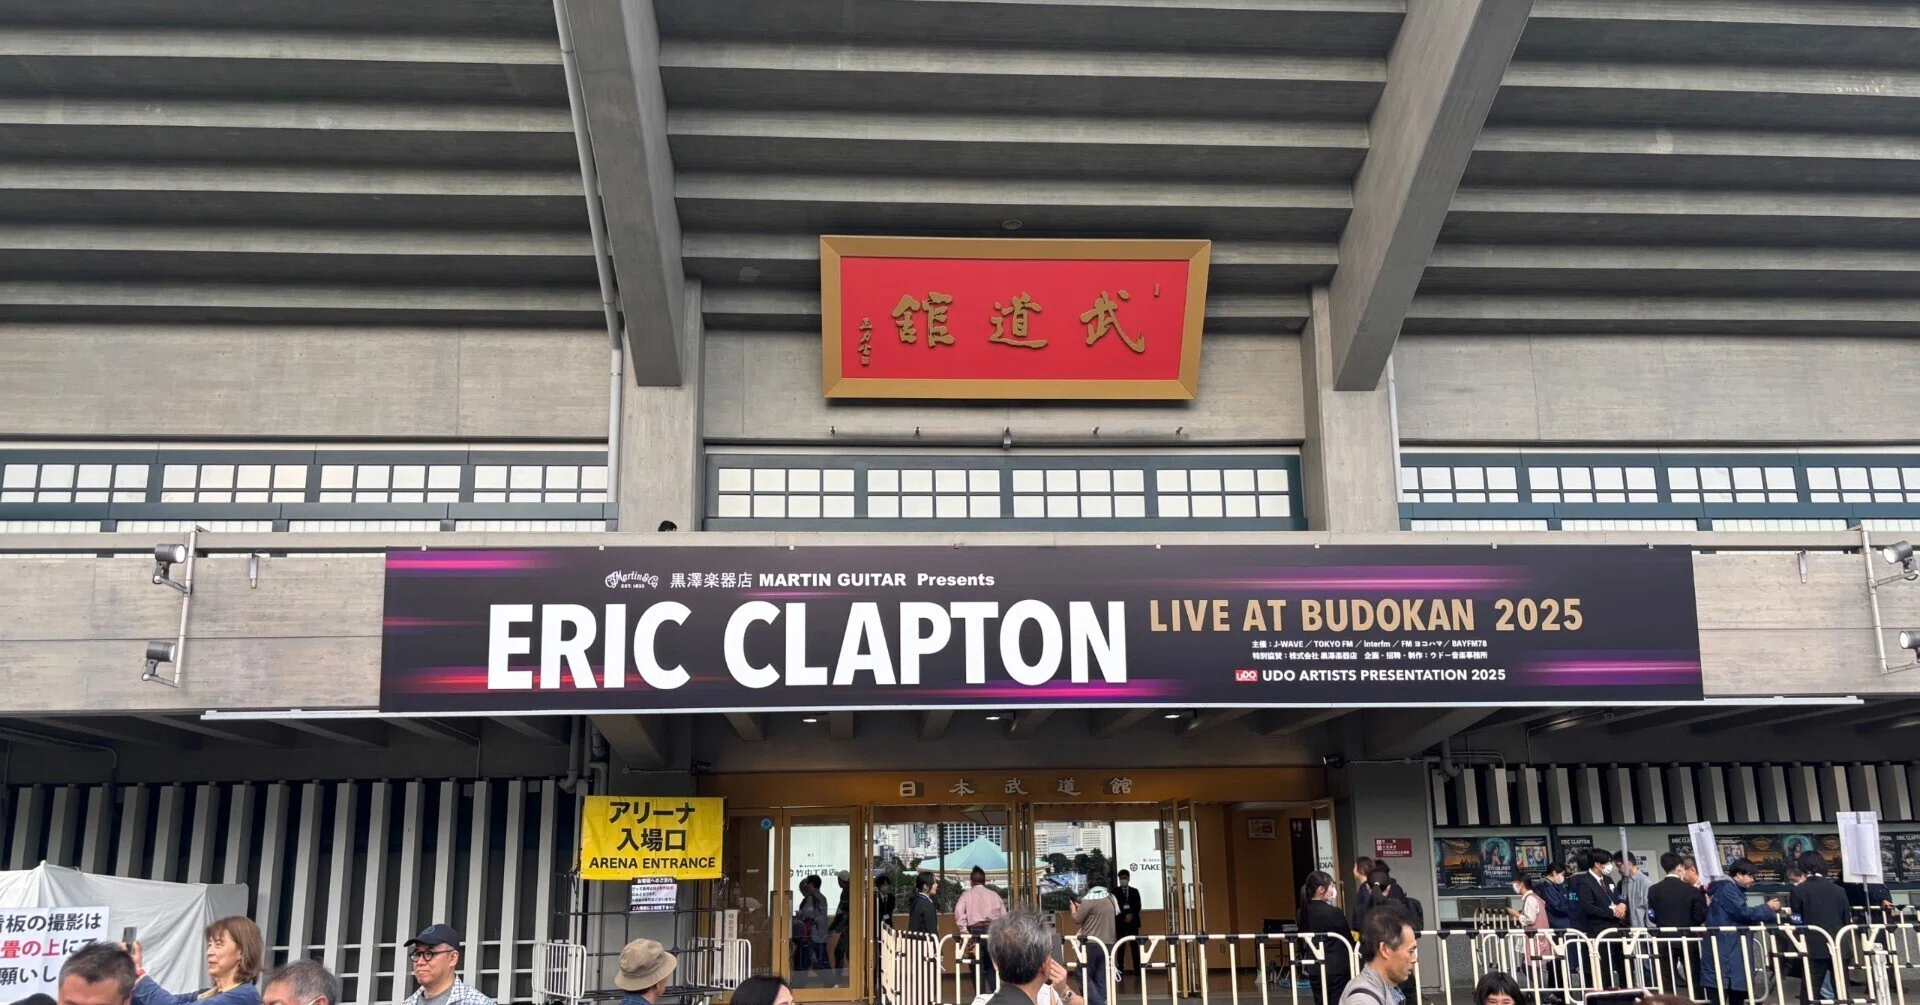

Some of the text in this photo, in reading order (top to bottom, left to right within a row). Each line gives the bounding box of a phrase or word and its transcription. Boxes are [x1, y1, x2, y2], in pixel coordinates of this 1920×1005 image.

[670, 572, 995, 589] 黒澤楽器店 MARTIN GUITAR Presents
[1150, 598, 1583, 632] LIVE AT BUDOKAN 2025
[488, 599, 1127, 690] ERIC CLAPTON
[1314, 640, 1340, 648] TOKYO
[1342, 640, 1353, 648] FM
[1262, 669, 1506, 681] UDO ARTISTS PRESENTATION 2025
[609, 801, 696, 824] アリーナ
[617, 828, 686, 851] 入場口
[589, 857, 716, 869] ARENA ENTRANCE
[0, 912, 102, 934] 板の撮影は
